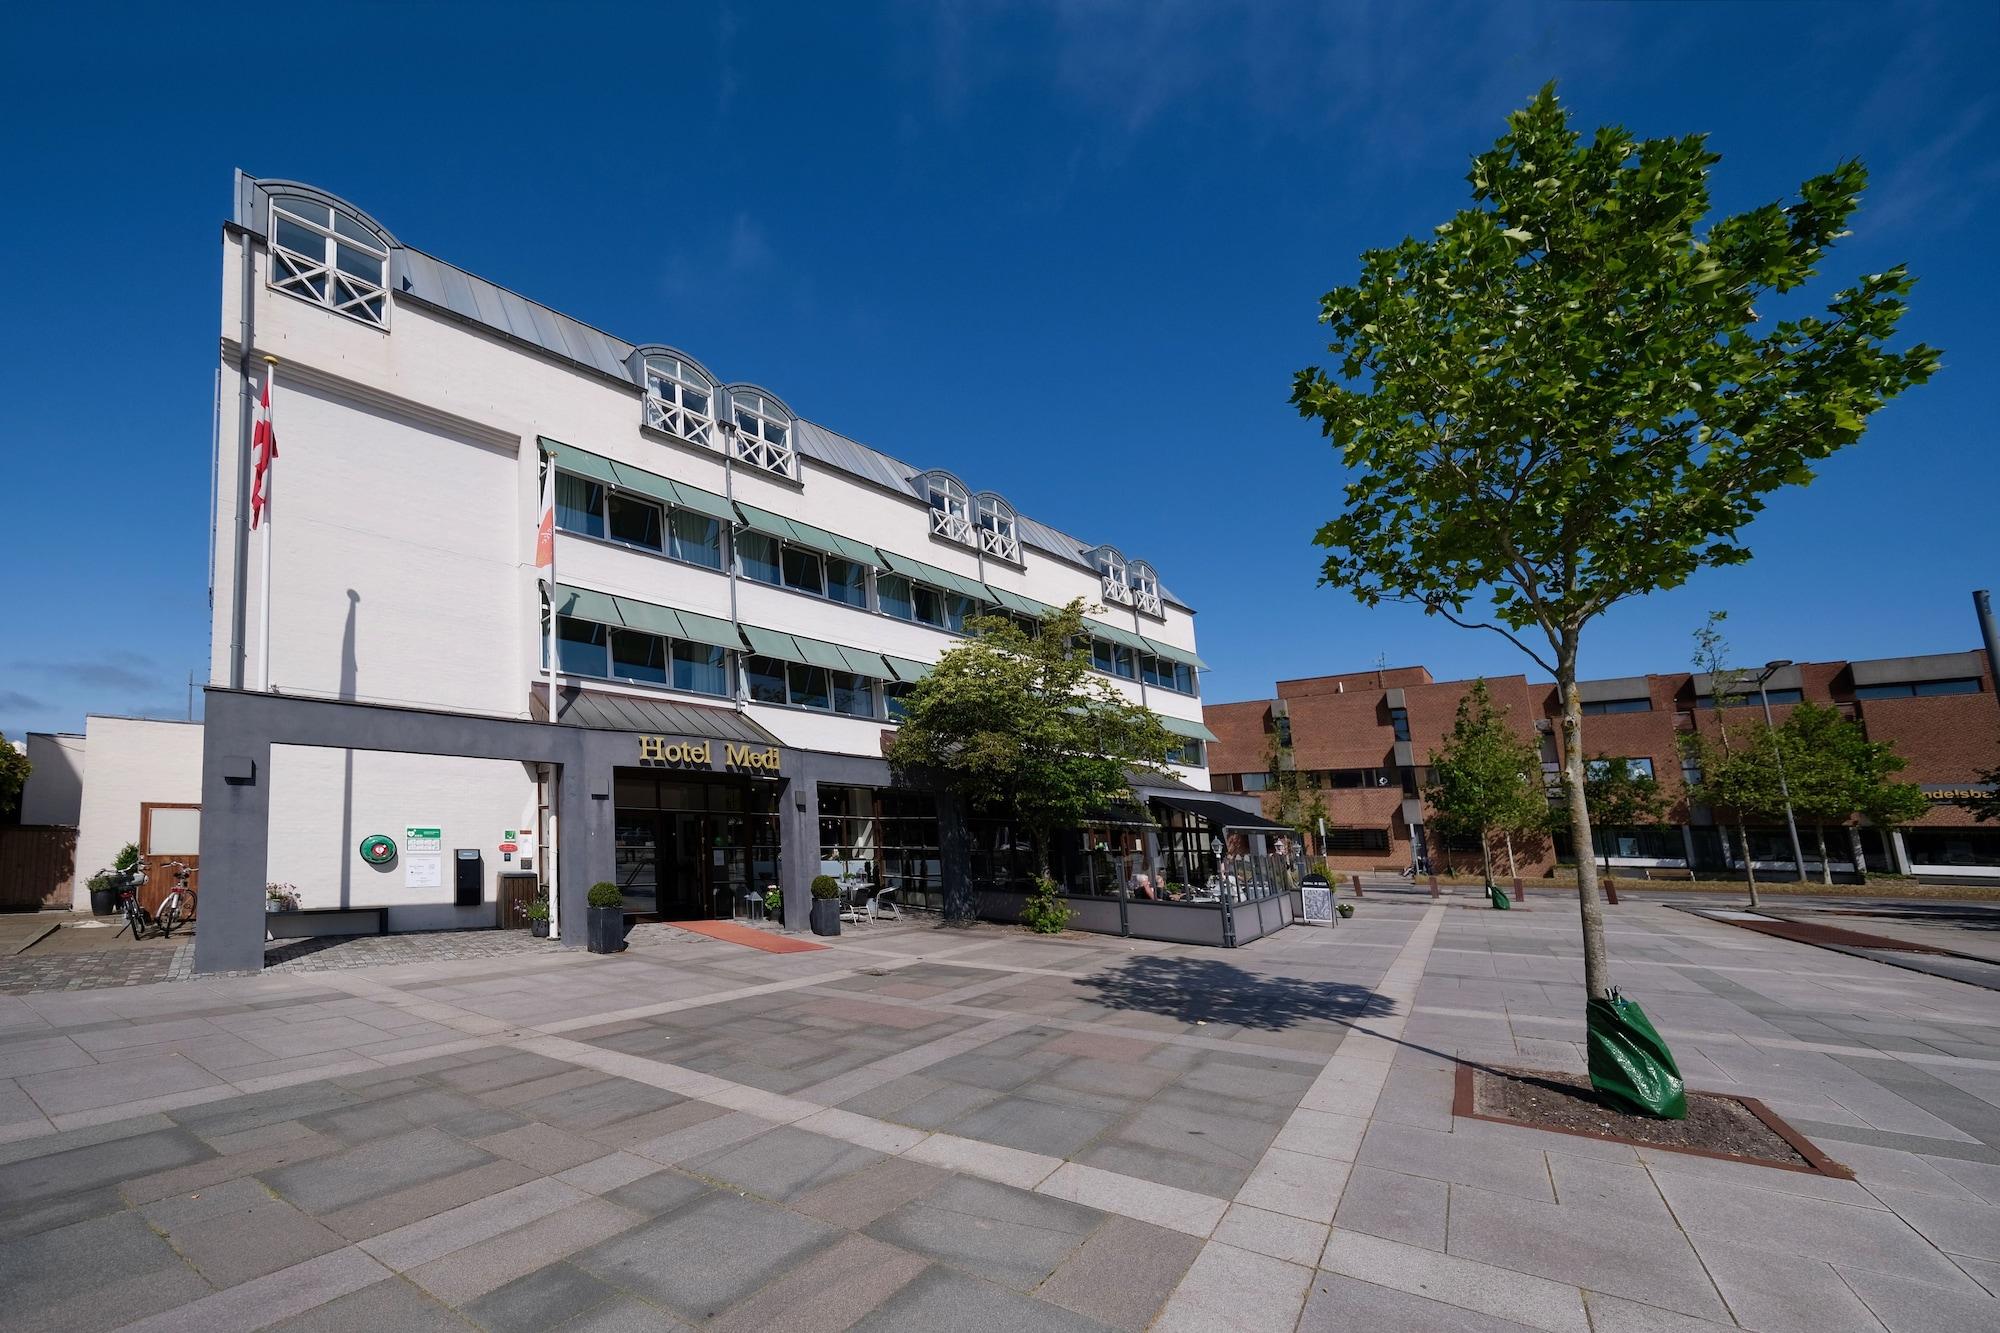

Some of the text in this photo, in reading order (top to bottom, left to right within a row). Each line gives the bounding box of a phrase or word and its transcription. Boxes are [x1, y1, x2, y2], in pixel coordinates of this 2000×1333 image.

[639, 736, 781, 770] Hotel Medi
[1920, 789, 1996, 799] ndelsba
